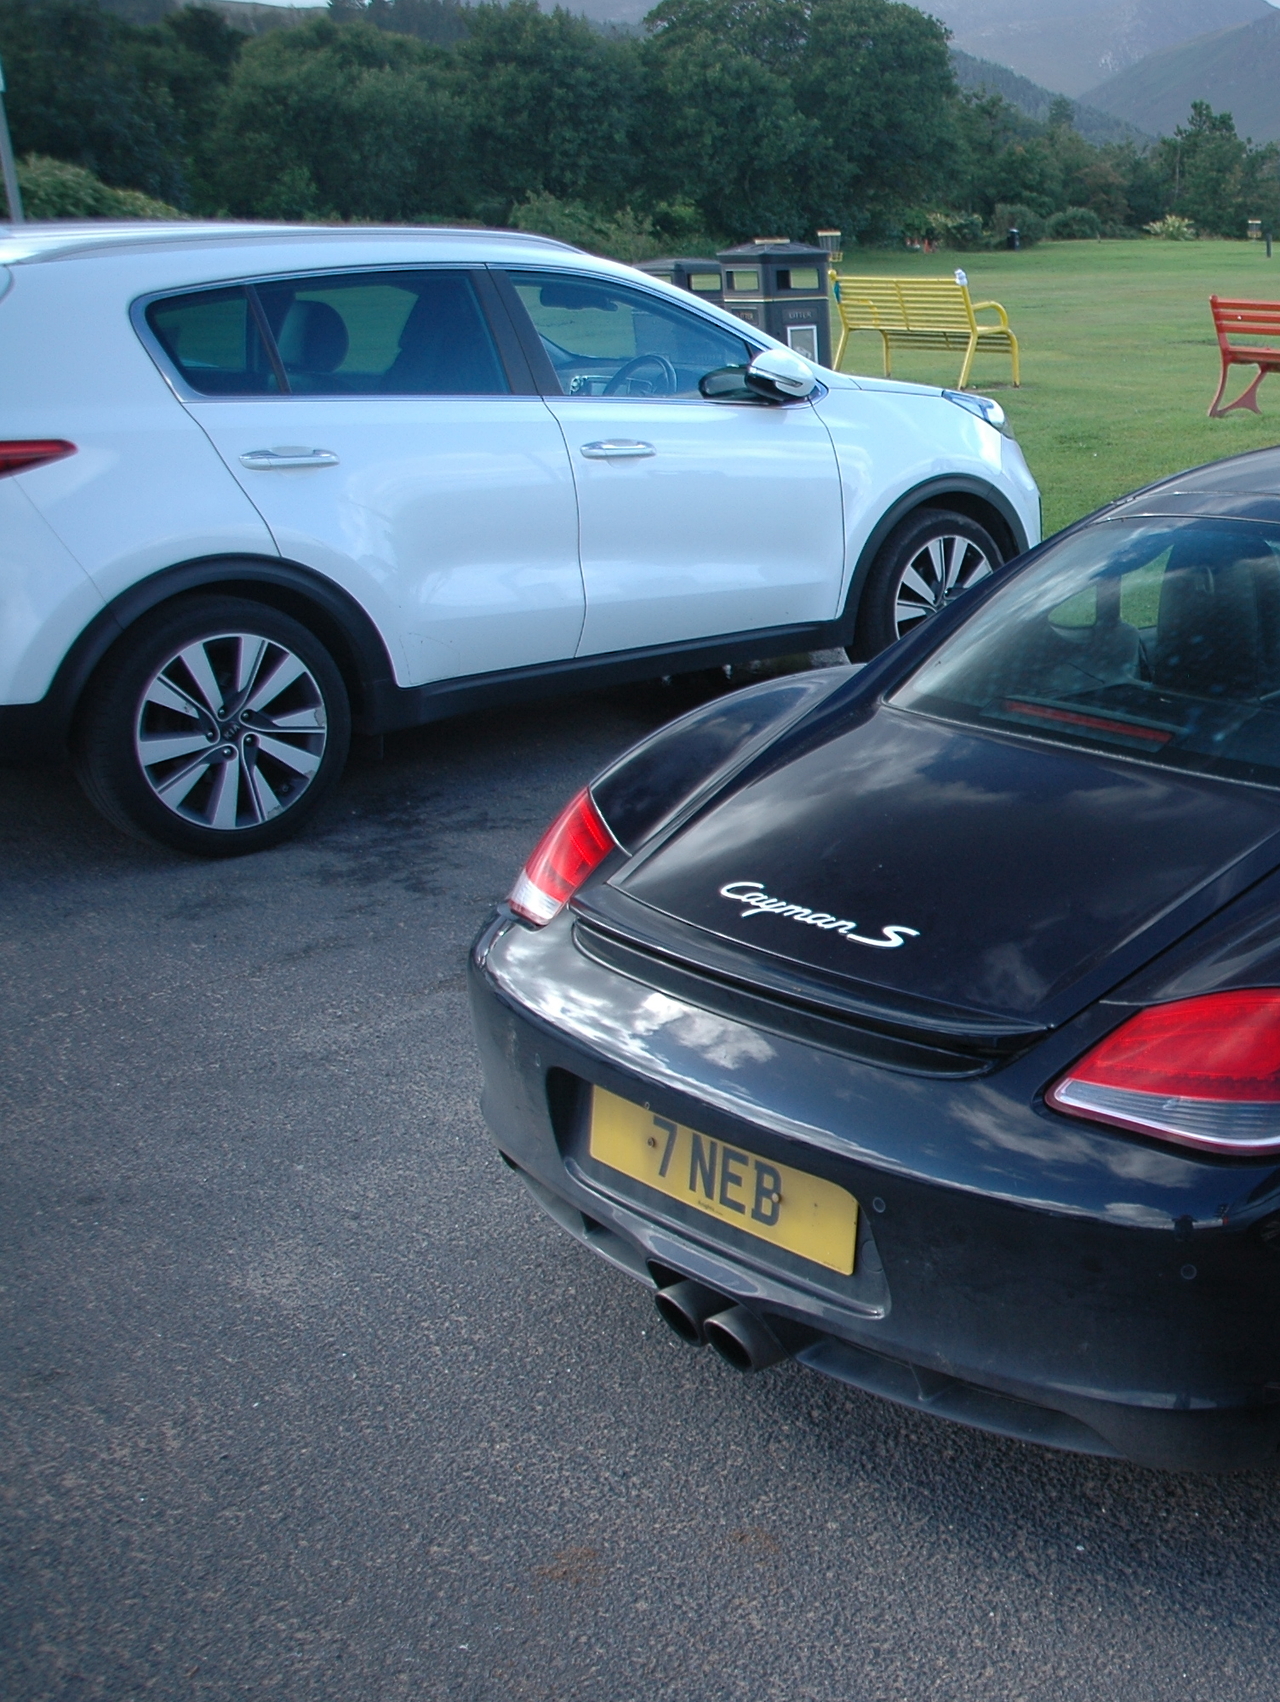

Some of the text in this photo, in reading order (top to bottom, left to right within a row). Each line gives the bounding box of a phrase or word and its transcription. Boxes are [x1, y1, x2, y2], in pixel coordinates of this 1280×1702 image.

[788, 311, 812, 319] LITTER
[720, 881, 921, 947] Cayman S
[652, 1115, 782, 1227] 7 NEB
